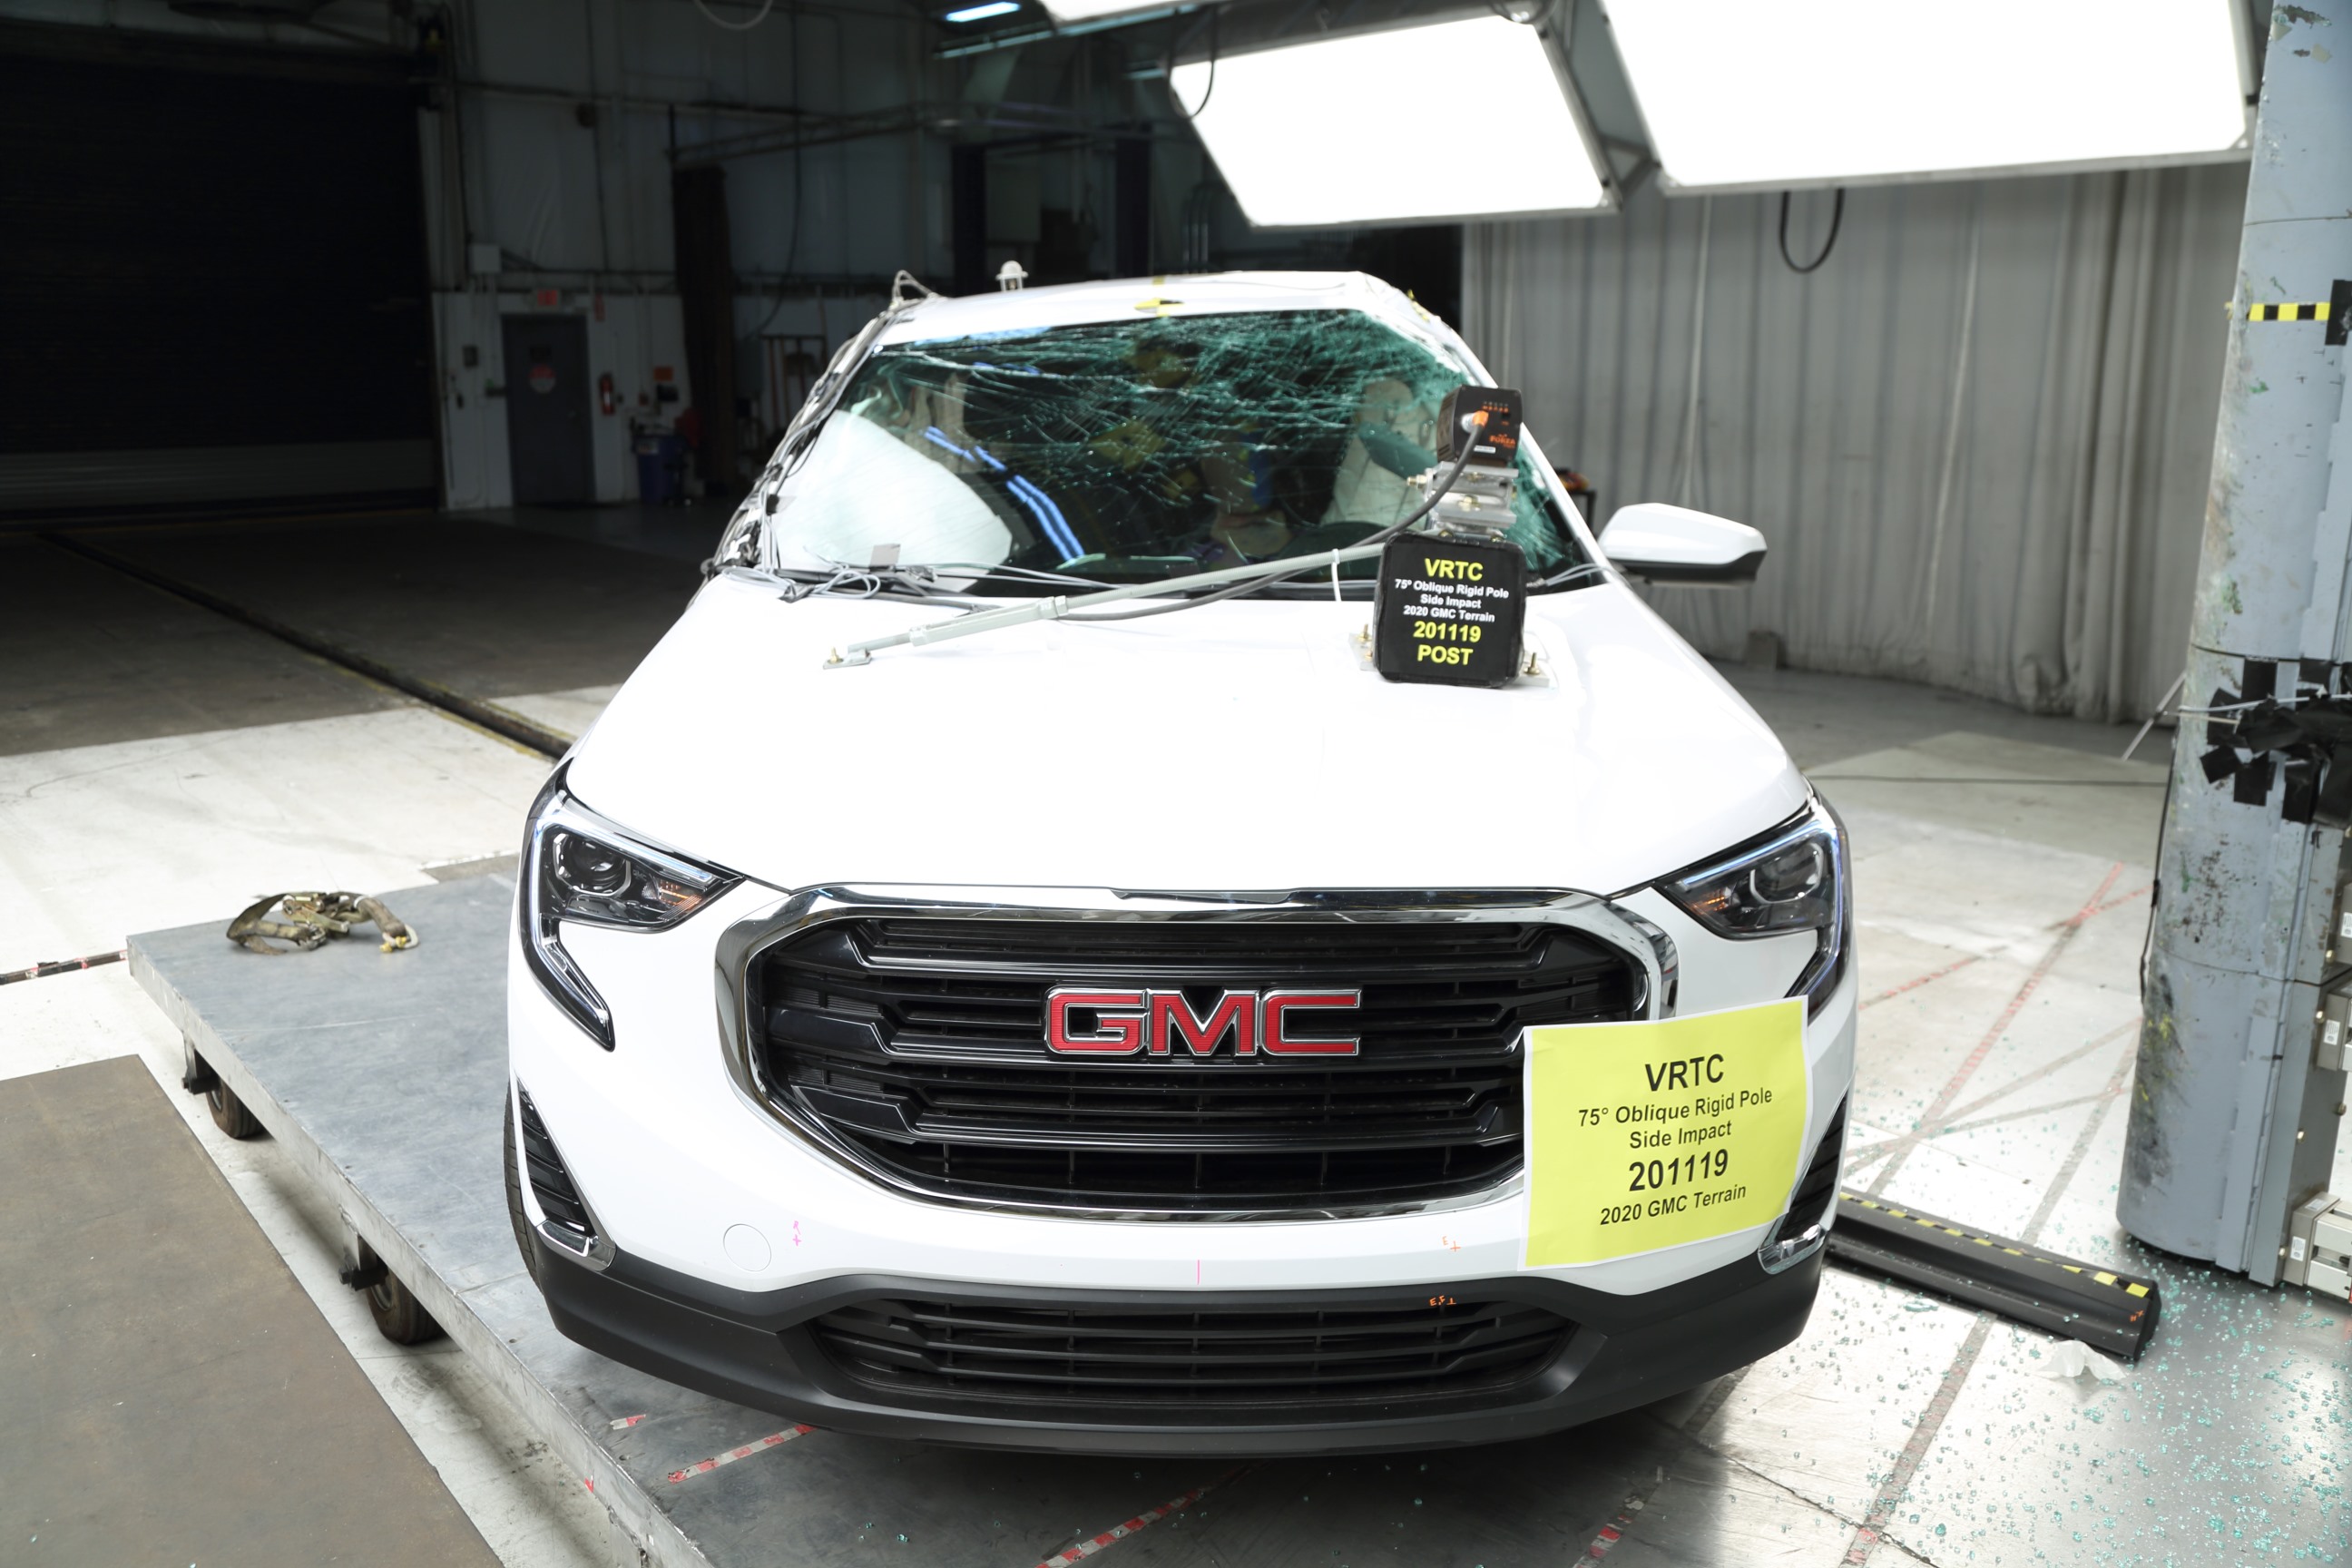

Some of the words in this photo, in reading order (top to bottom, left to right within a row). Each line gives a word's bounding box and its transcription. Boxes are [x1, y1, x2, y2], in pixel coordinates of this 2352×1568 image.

[1425, 558, 1483, 581] VRTC
[1414, 580, 1454, 595] Oblique
[1455, 583, 1483, 598] Rigid
[1485, 587, 1509, 599] Pole
[1420, 593, 1443, 605] Side
[1446, 596, 1481, 609] Impact
[1404, 604, 1428, 616] 2020
[1431, 607, 1456, 620] GMC
[1458, 609, 1494, 622] Terrain
[1414, 621, 1481, 642] 201119
[1417, 644, 1474, 665] POST
[1044, 987, 1361, 1056] GMC
[1645, 1054, 1724, 1092] VRTC
[1615, 1105, 1690, 1123] Oblique
[1695, 1093, 1734, 1117] Rigid
[1740, 1087, 1772, 1107] Pole
[1630, 1130, 1671, 1149] Side
[1679, 1120, 1731, 1145] Impact
[1629, 1149, 1729, 1191] 201119
[1600, 1203, 1642, 1225] 2020
[1648, 1195, 1687, 1217] GMC
[1694, 1184, 1746, 1209] Terrain
